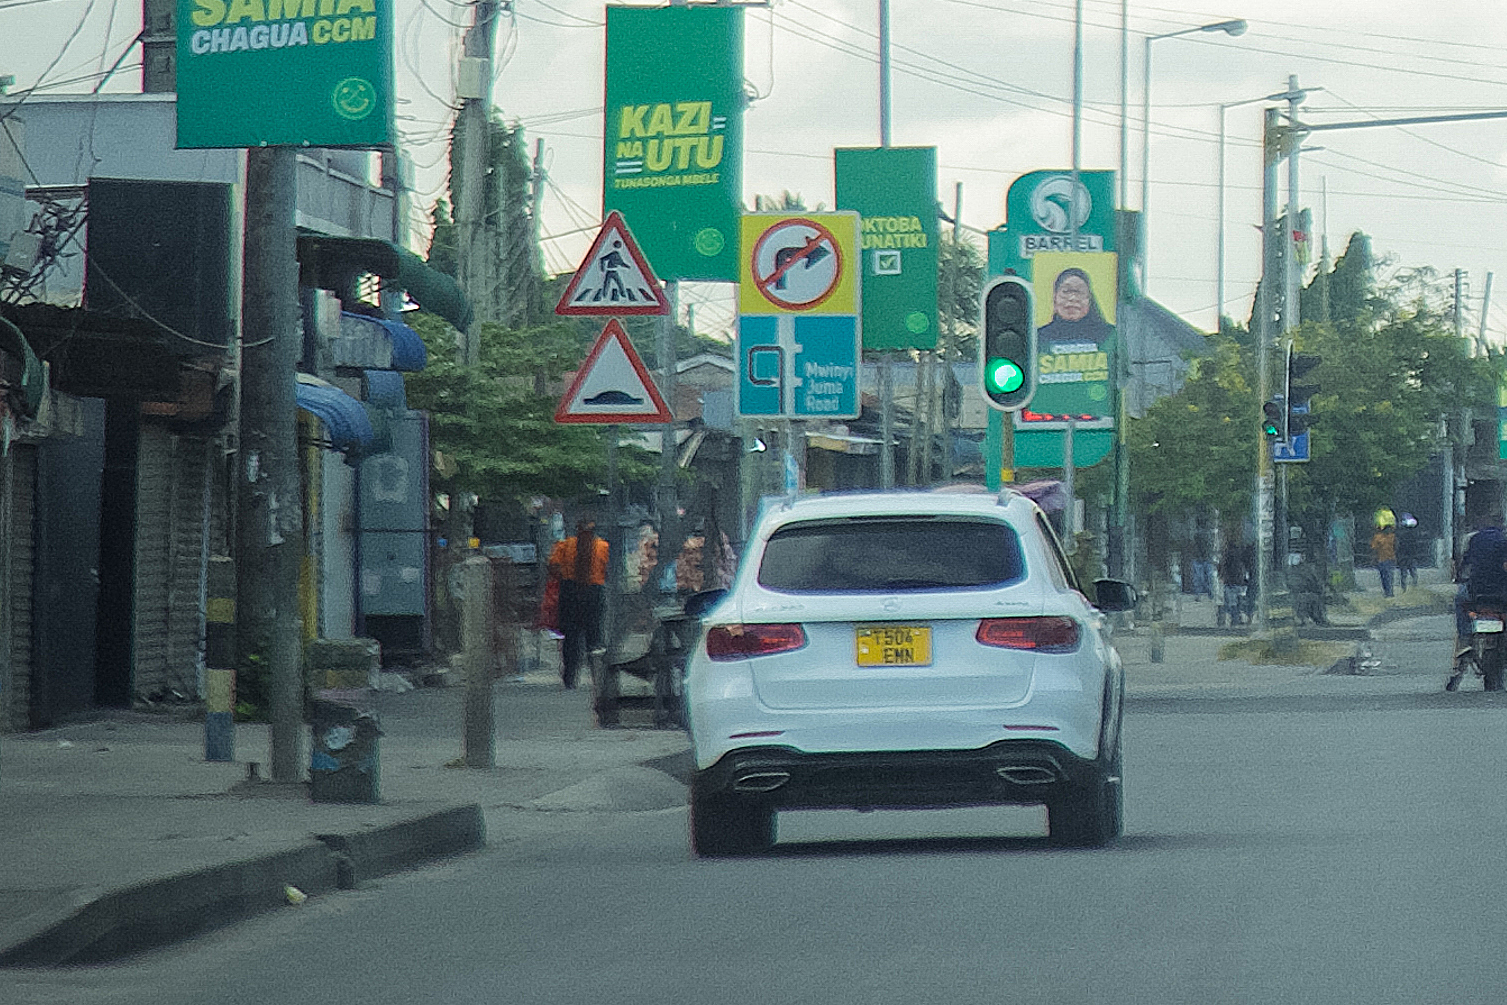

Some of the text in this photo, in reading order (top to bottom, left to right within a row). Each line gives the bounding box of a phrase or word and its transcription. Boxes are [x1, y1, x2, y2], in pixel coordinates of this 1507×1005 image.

[191, 16, 377, 54] CHAGUA CCM
[619, 101, 713, 138] KAZI
[616, 135, 724, 172] NA UTU
[861, 216, 922, 233] KTOBA
[861, 233, 928, 249] UNATIKI
[1025, 236, 1097, 251] BARREL
